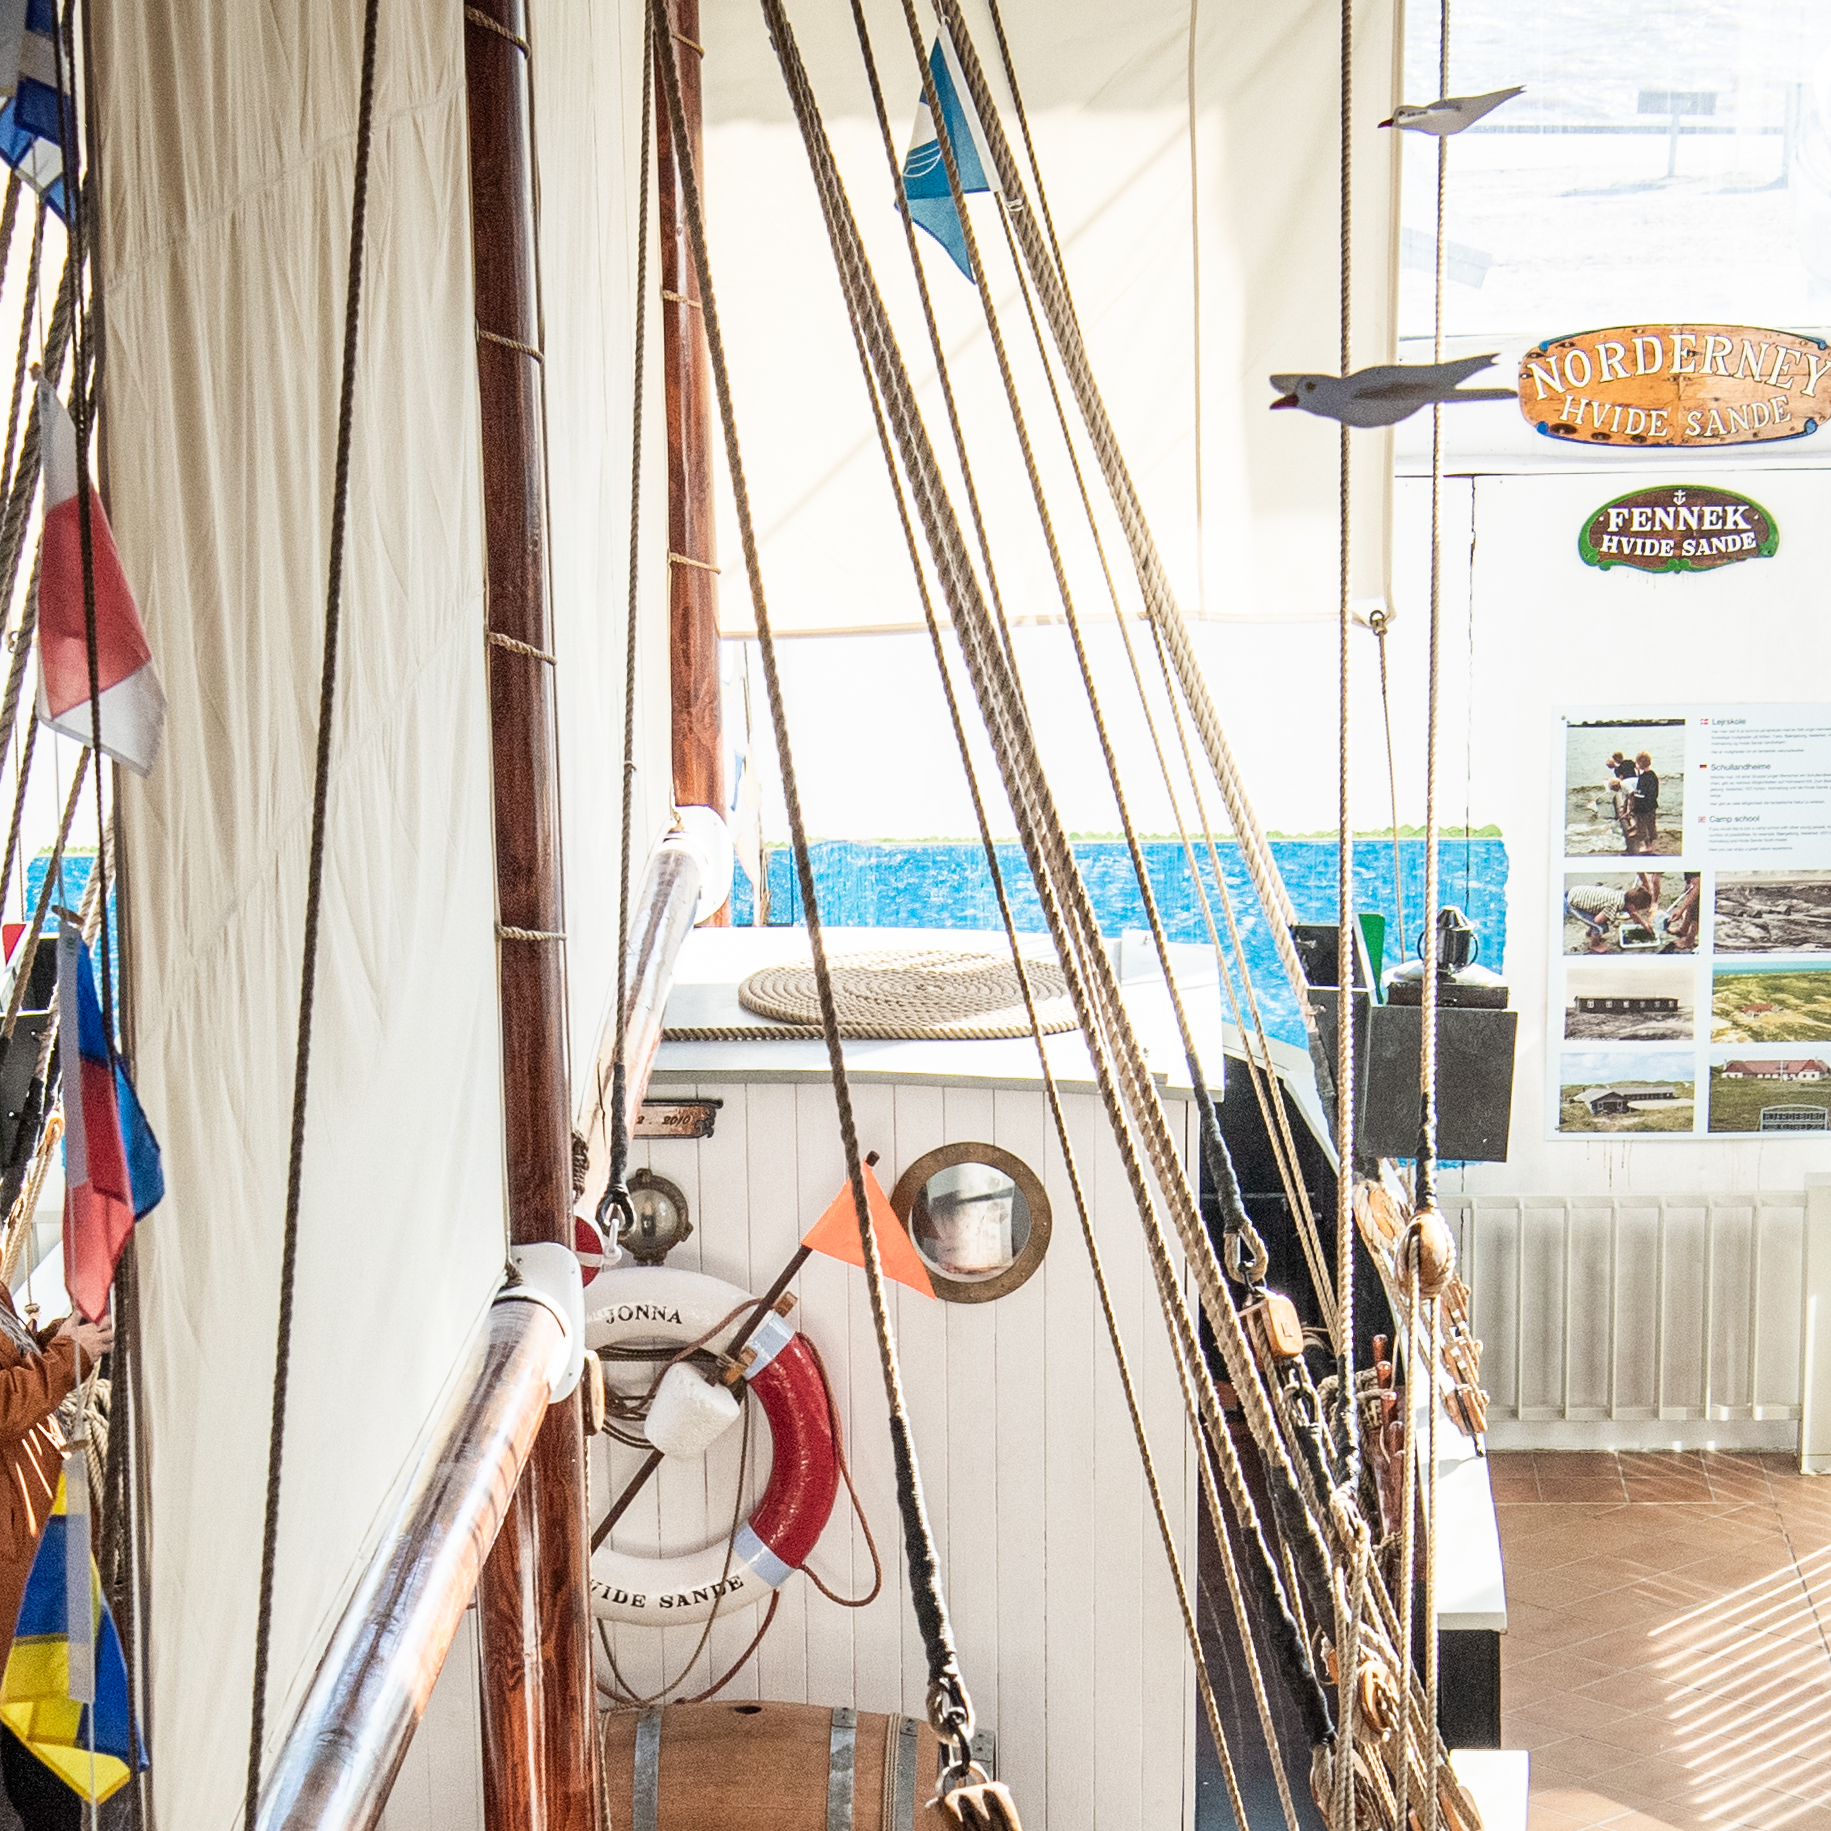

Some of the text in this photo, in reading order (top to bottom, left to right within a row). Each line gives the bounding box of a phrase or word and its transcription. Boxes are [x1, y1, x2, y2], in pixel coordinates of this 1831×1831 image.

[1559, 394, 1794, 438] HVIDE SANDE
[1606, 505, 1752, 533] FENNEK
[1599, 531, 1758, 558] HVIDE SANDE
[1708, 814, 1760, 825] Camp school
[662, 1114, 691, 1126] 2010
[605, 1304, 683, 1326] JONNA
[659, 1574, 744, 1609] SANDE
